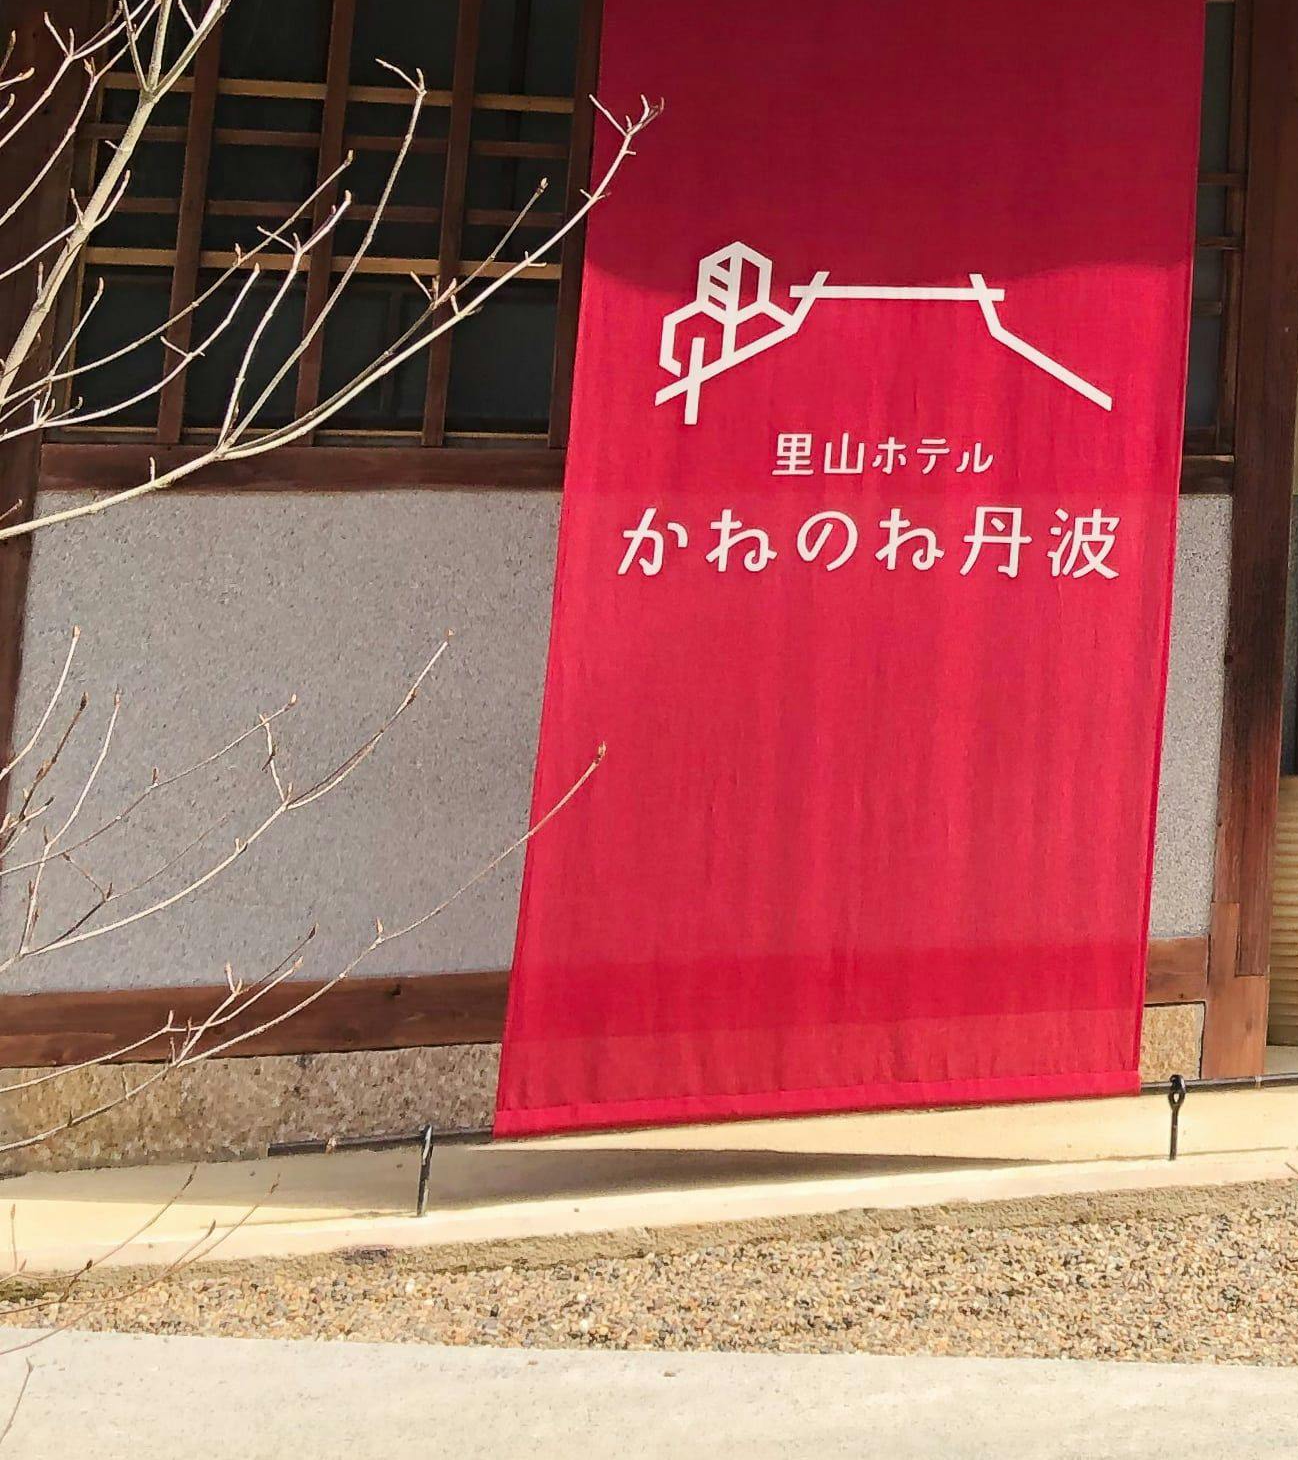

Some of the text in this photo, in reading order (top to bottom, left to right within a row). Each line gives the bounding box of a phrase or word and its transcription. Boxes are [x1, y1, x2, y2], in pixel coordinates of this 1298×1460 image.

[771, 432, 994, 476] 里山ホテル
[617, 505, 1120, 579] かねのね丹波
